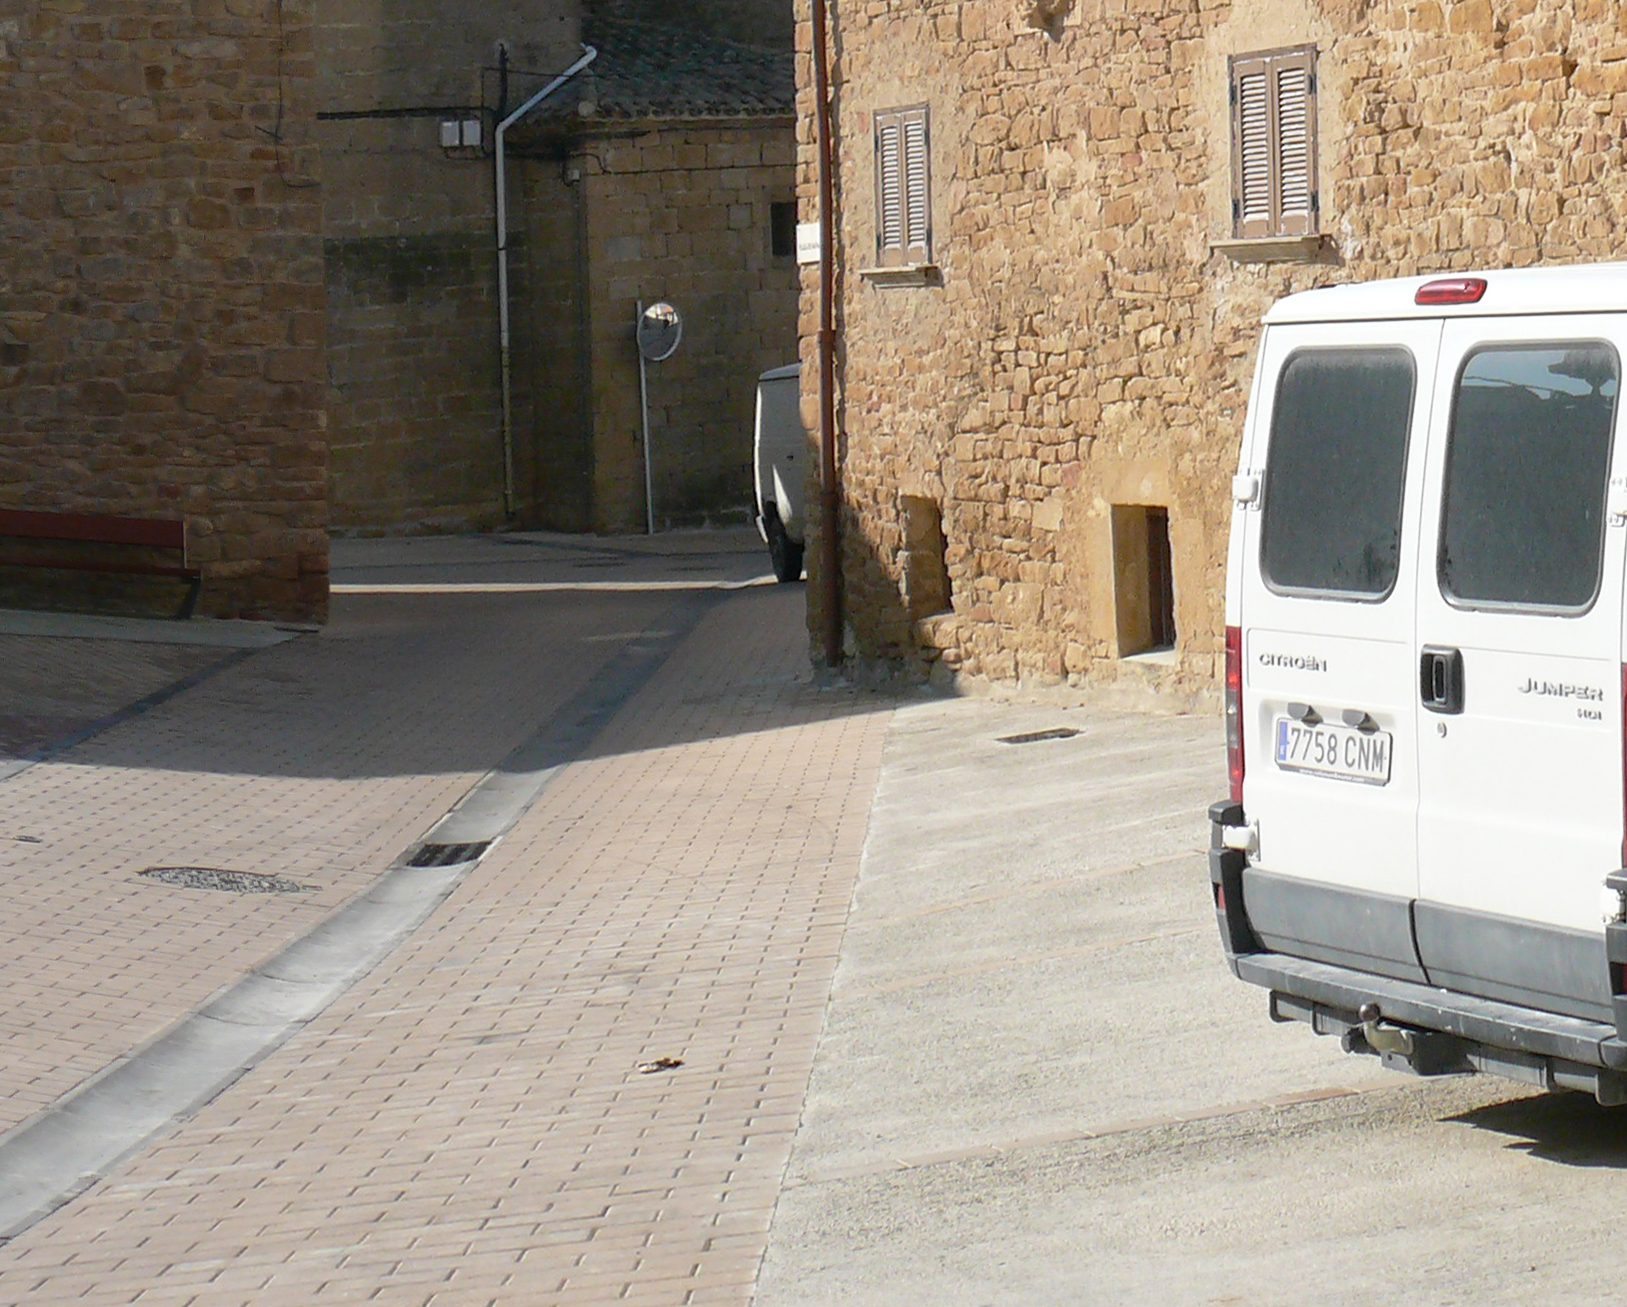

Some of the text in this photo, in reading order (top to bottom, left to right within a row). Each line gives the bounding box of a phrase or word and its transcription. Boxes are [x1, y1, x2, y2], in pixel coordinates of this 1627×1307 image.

[1517, 677, 1604, 701] JUMPER
[1289, 726, 1385, 774] 7758 CNM
